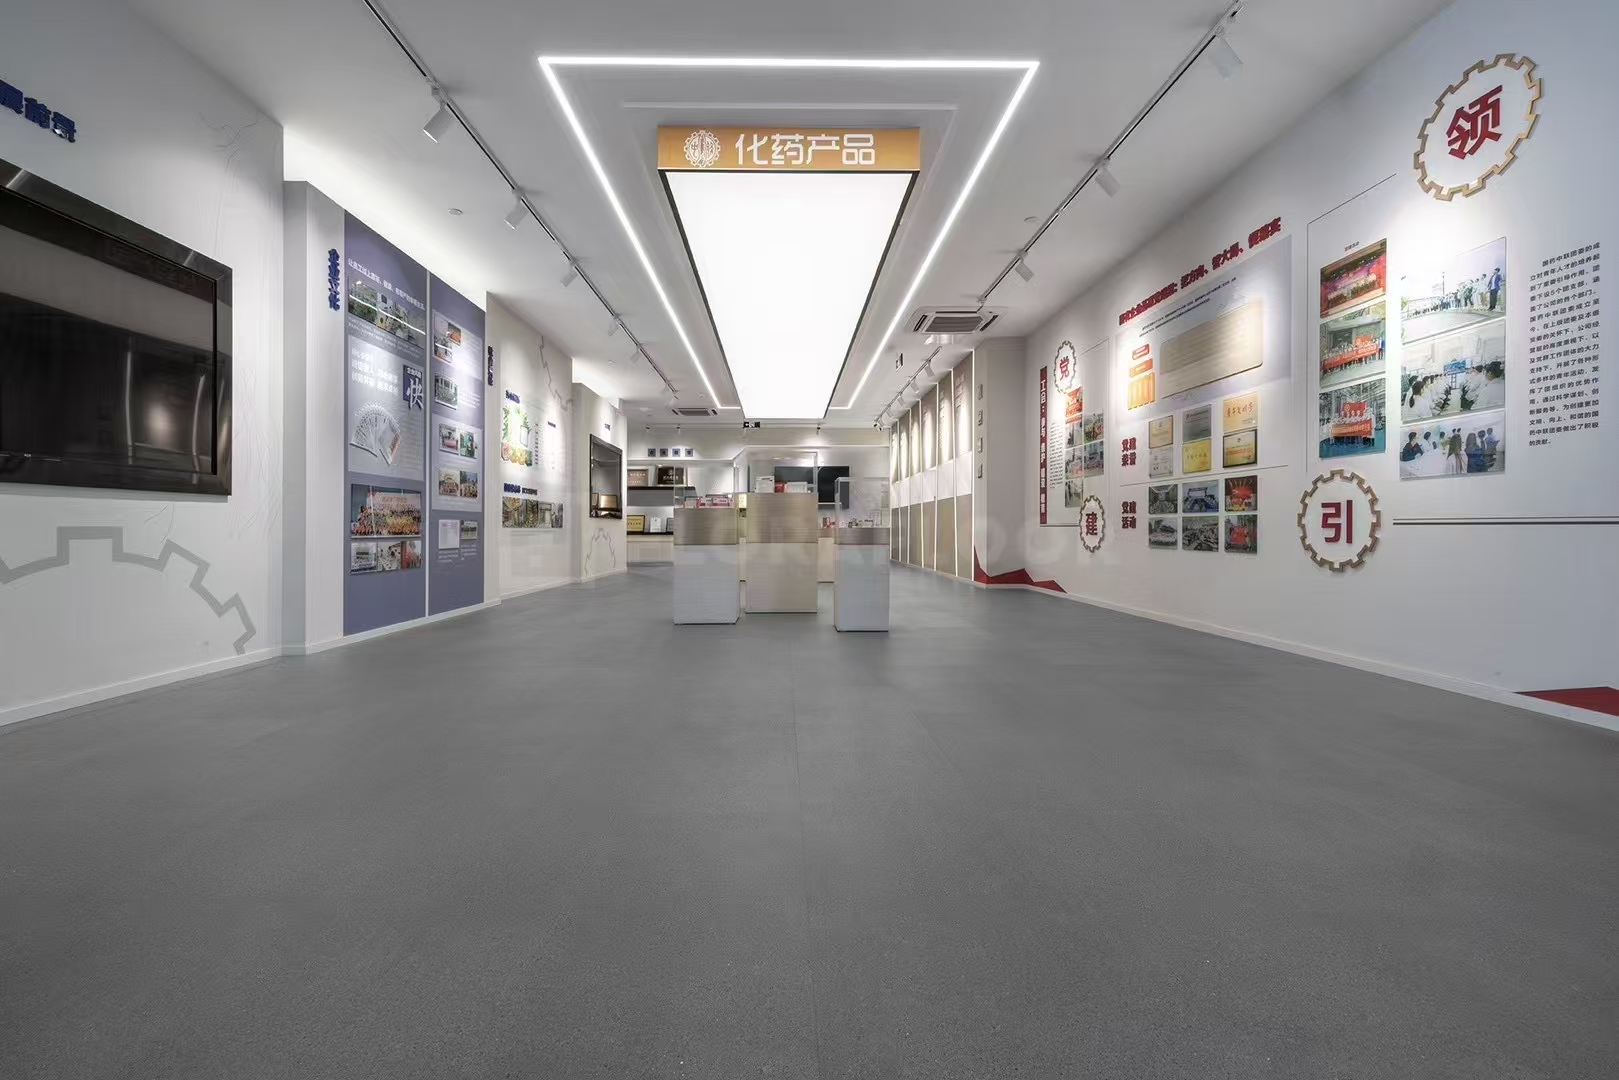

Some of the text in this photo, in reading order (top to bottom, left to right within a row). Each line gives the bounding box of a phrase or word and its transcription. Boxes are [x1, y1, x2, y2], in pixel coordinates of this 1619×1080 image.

[1446, 85, 1503, 159] 领
[735, 133, 875, 165] 化药产品
[1542, 242, 1600, 267] 国药中联团委的成
[1060, 356, 1070, 381] 党
[406, 378, 423, 409] 快
[1086, 512, 1098, 536] 建
[1321, 500, 1353, 544] 引
